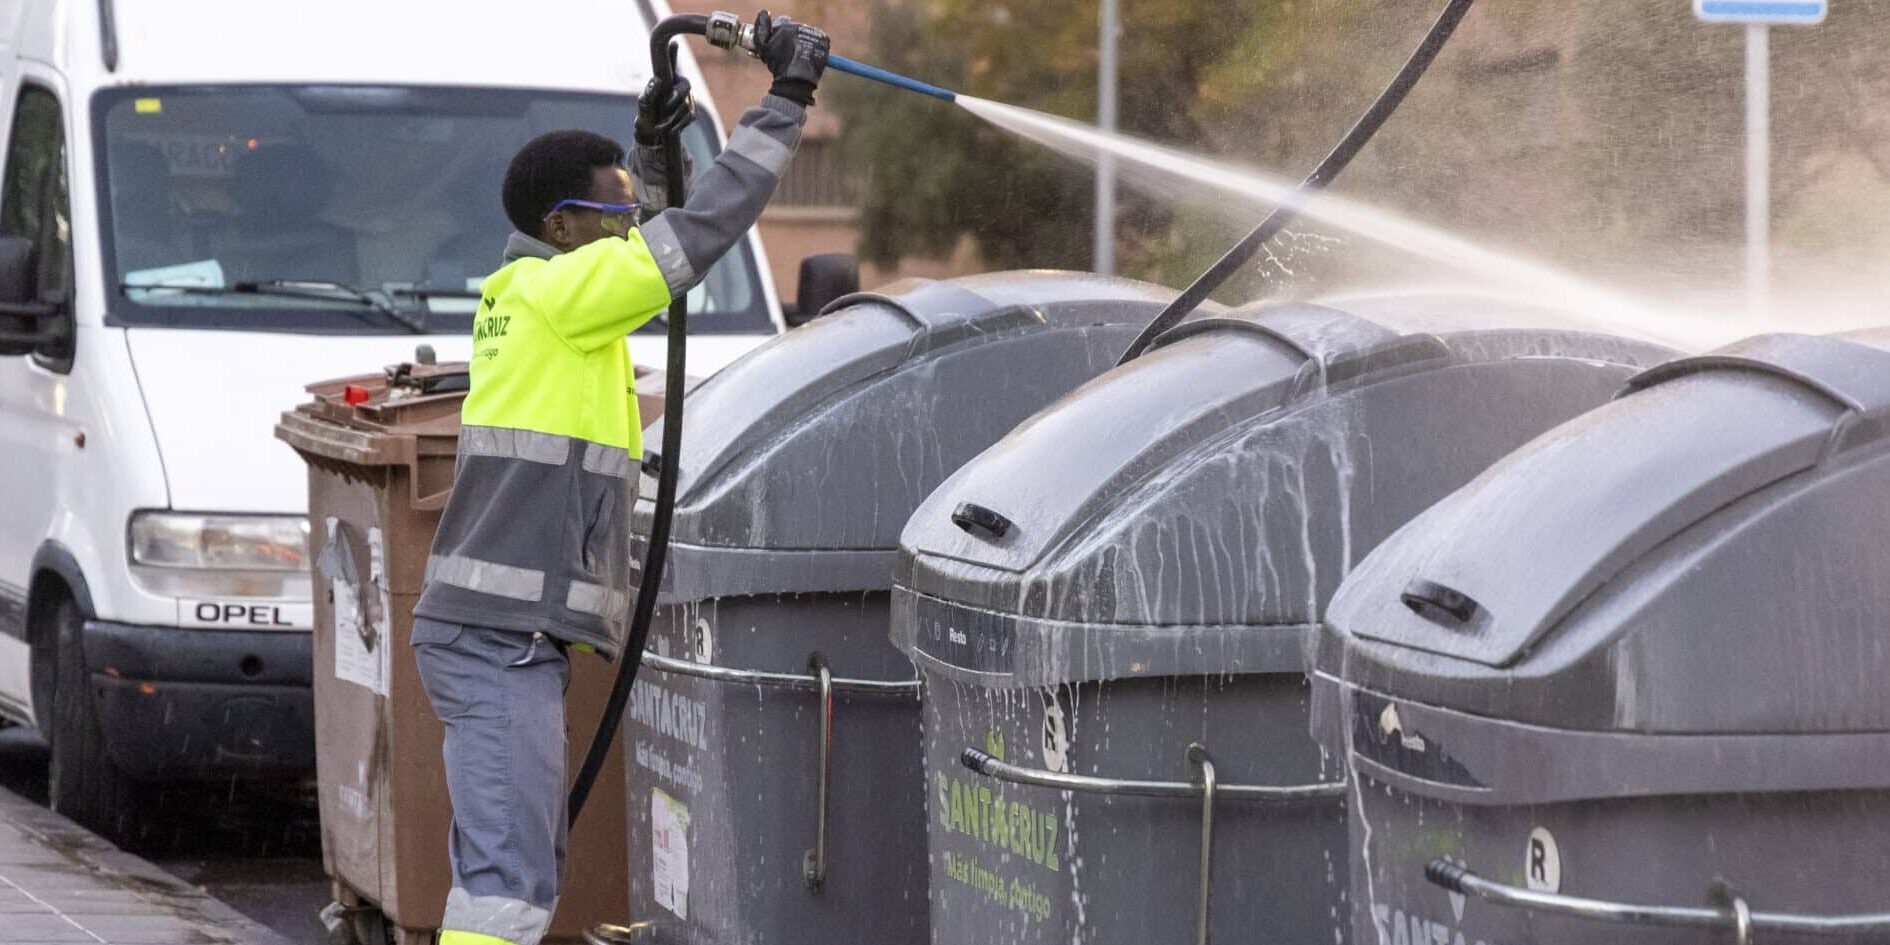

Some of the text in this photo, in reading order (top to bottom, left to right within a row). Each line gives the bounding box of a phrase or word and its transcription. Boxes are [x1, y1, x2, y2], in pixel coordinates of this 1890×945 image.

[195, 602, 293, 626] OPEL
[949, 627, 967, 645] Resto
[938, 770, 1060, 871] SANTACRUZ
[1530, 836, 1548, 883] R
